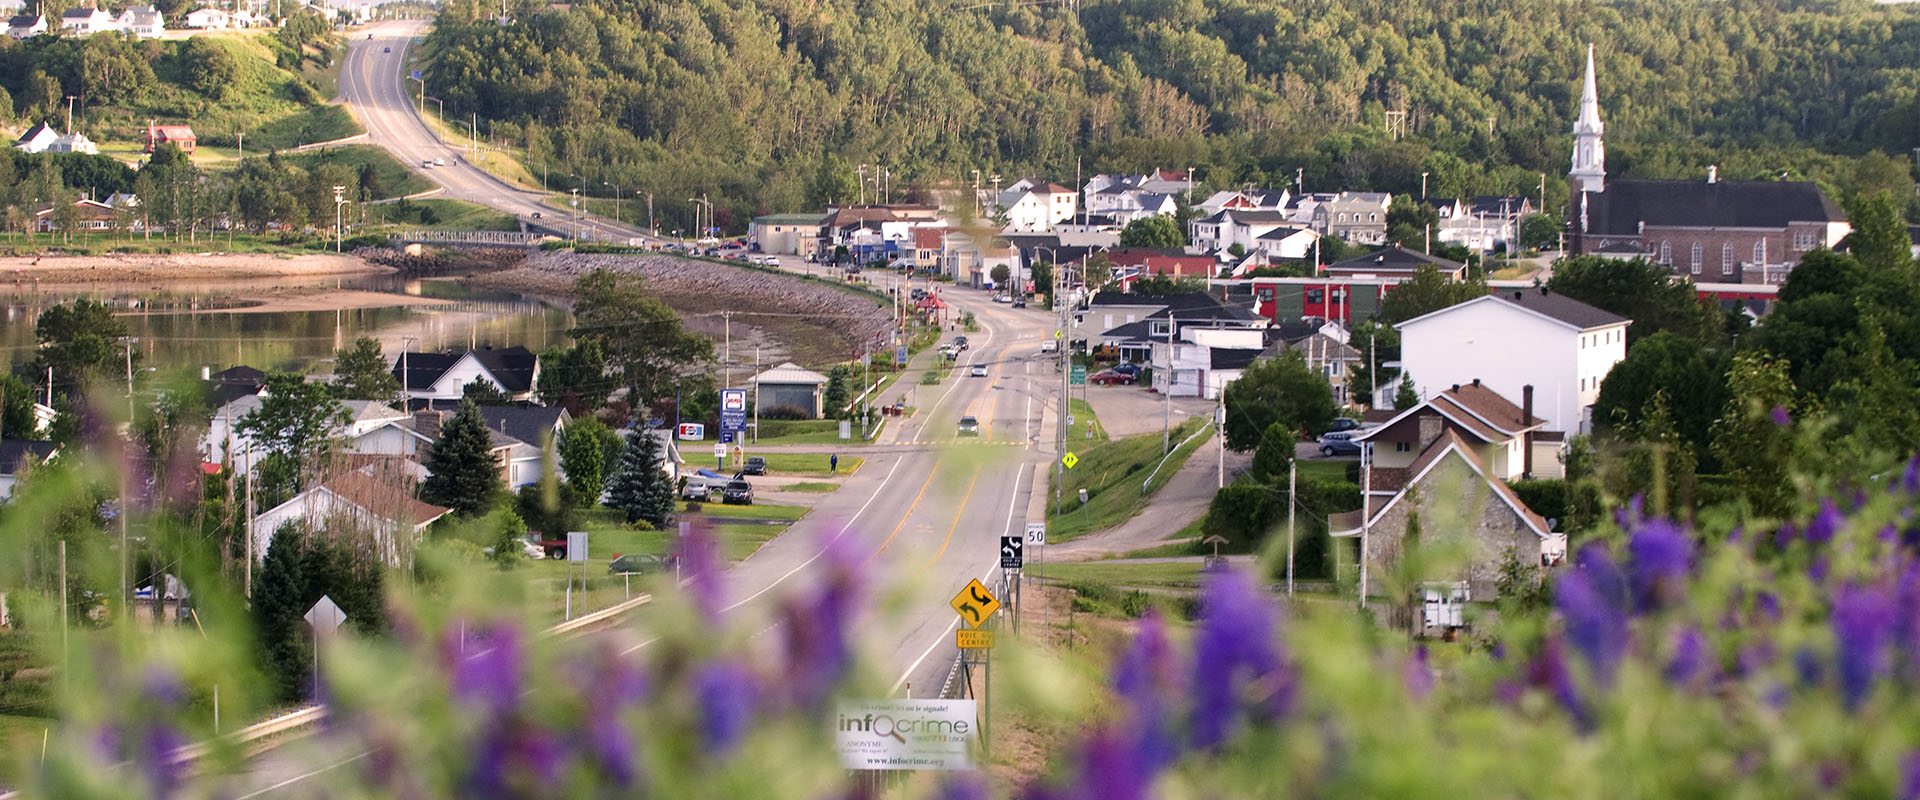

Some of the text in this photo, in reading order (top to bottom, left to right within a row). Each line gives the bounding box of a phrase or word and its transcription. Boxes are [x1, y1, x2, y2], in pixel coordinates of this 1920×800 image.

[1028, 530, 1044, 542] 50
[960, 631, 977, 639] VOIE
[867, 756, 945, 766] www.infocrime.org
